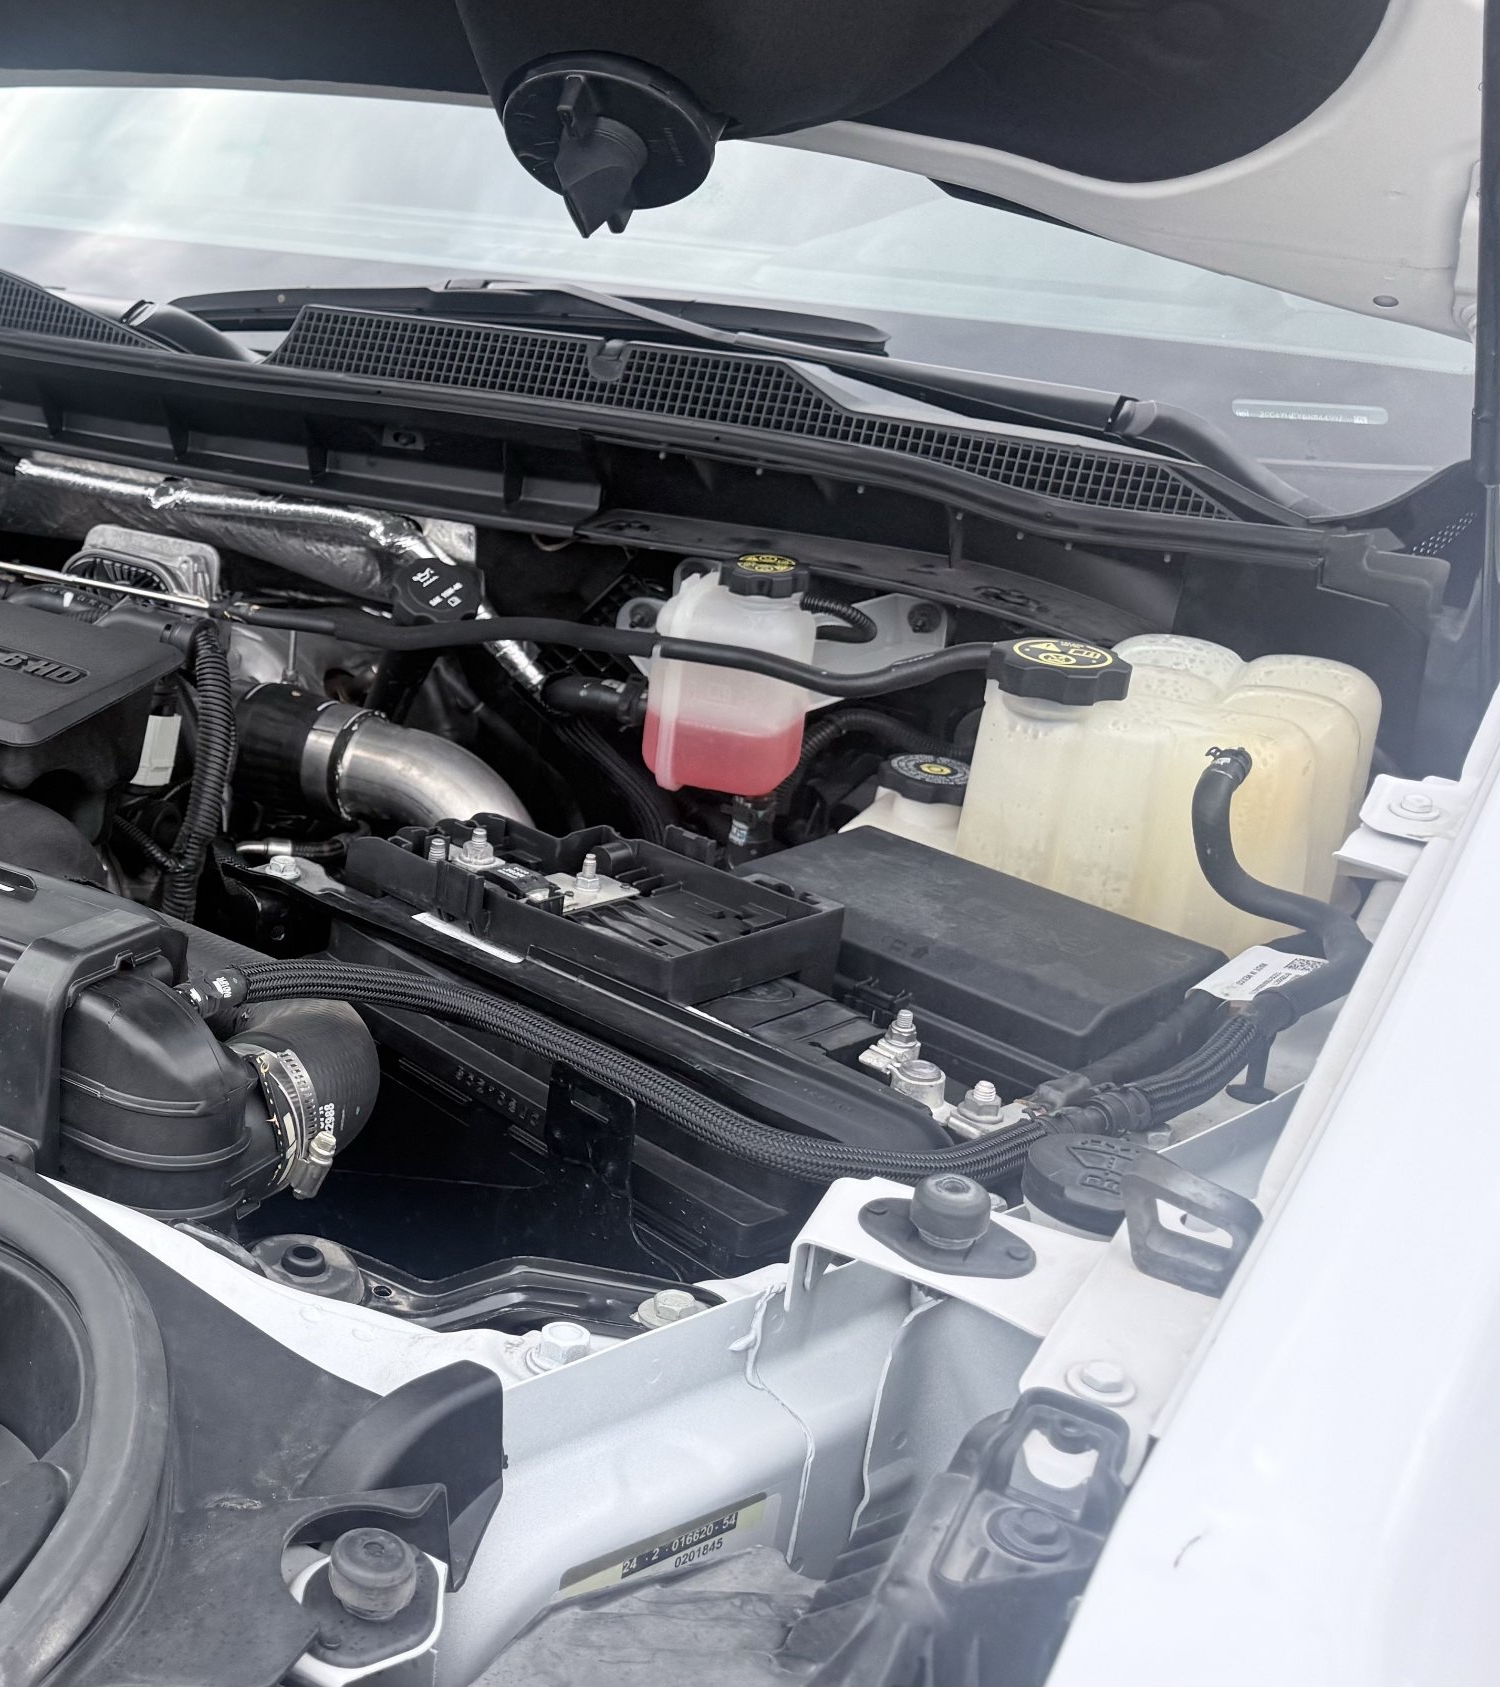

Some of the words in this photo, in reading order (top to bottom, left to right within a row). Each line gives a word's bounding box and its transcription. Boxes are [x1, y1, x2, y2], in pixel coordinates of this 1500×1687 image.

[22, 660, 82, 684] HD
[323, 1102, 336, 1135] 2988
[622, 1557, 638, 1574] 24
[722, 1513, 737, 1530] 54
[674, 1538, 723, 1568] 0201845
